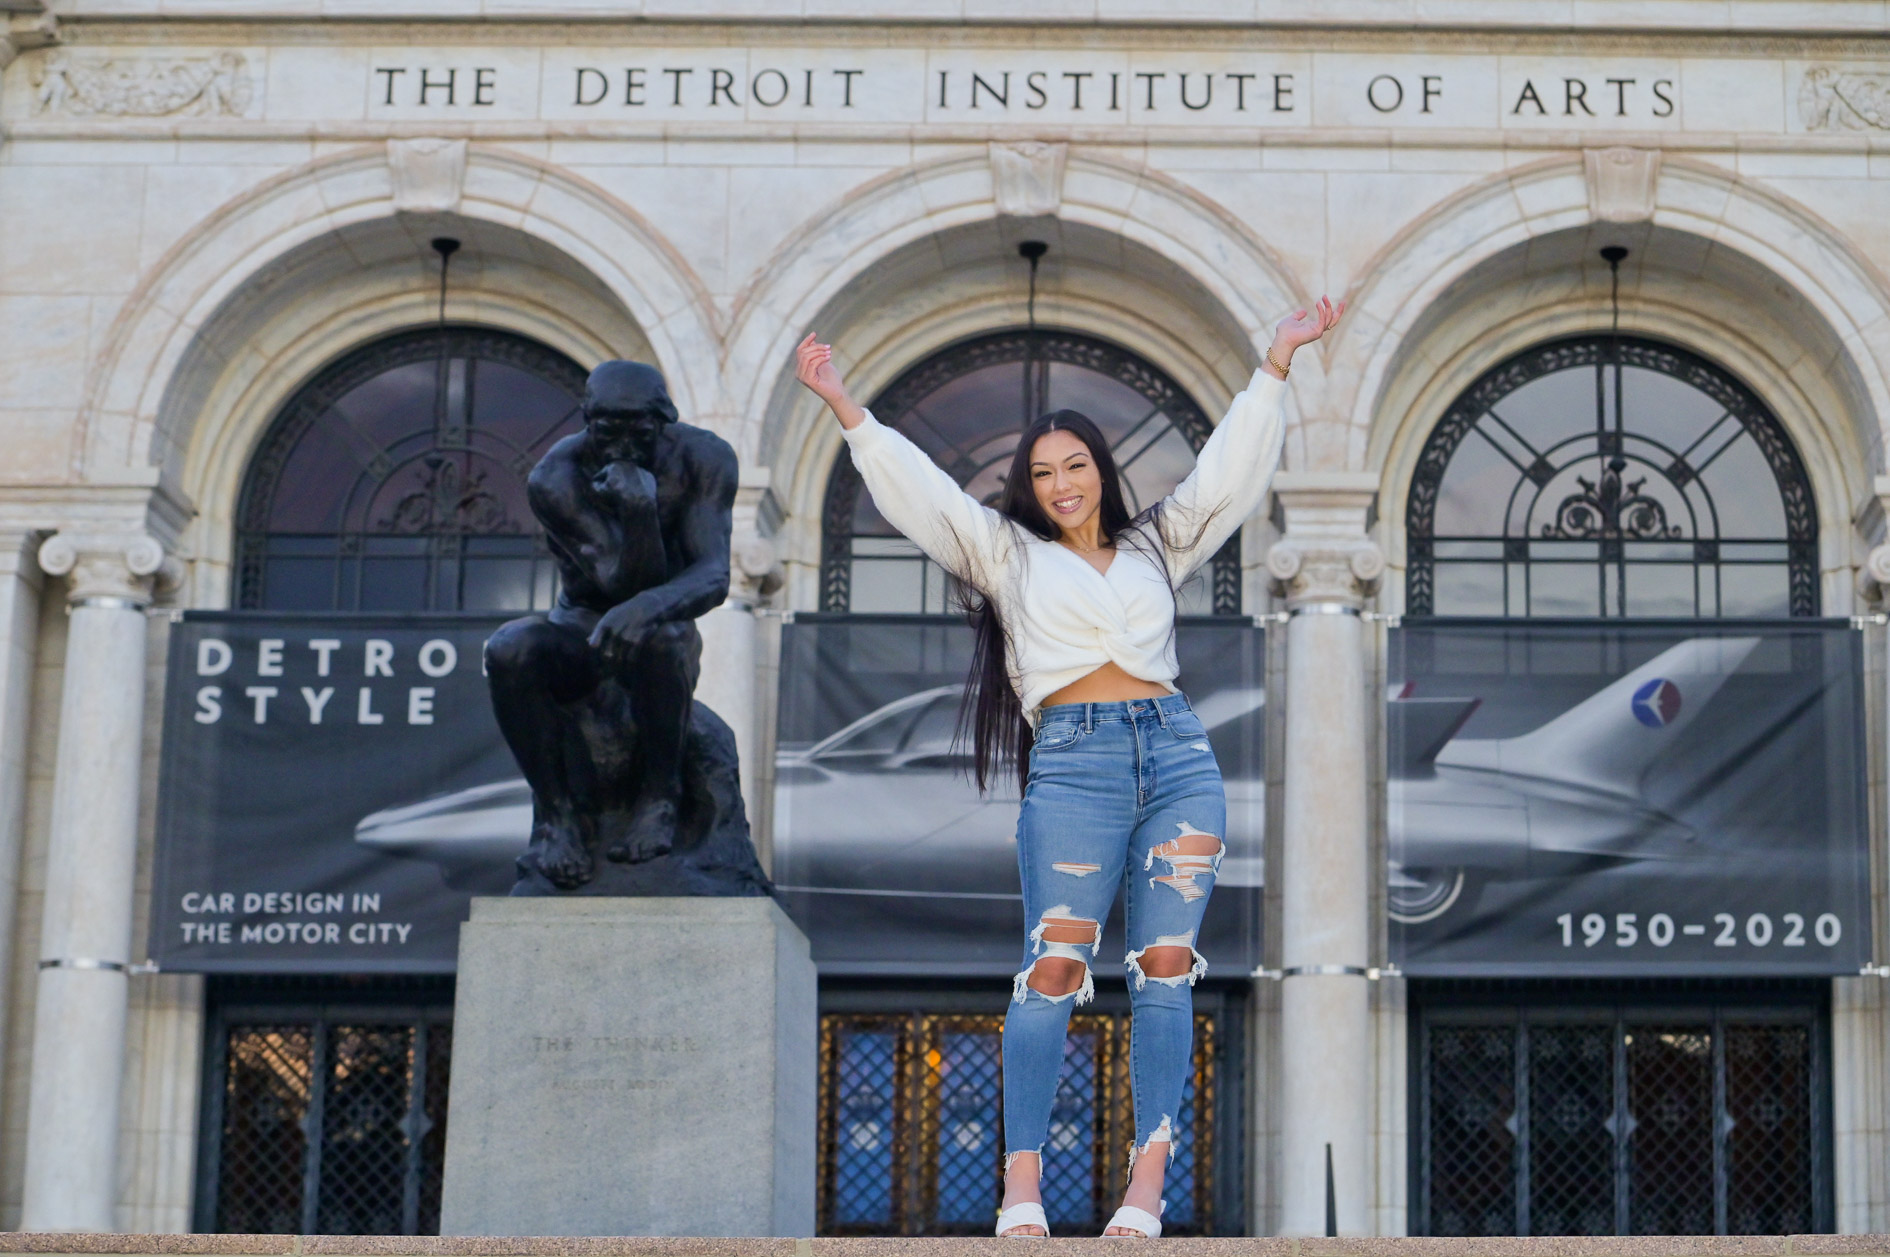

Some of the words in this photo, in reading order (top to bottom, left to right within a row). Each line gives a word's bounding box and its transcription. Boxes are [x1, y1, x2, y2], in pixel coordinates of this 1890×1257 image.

[376, 67, 496, 107] THE
[574, 67, 864, 108] DETROIT
[937, 71, 1294, 113] INSTITUTE
[1366, 75, 1443, 114] OF
[1512, 78, 1675, 117] ARTS
[197, 638, 488, 676] DETRO
[194, 685, 436, 725] STYLE
[181, 892, 235, 914] CAR
[243, 892, 344, 914] DESIGN
[352, 893, 381, 913] IN
[181, 922, 232, 944] THE
[240, 922, 341, 944] MOTOR
[349, 923, 412, 944] CITY
[533, 1036, 574, 1052] THE
[592, 1036, 699, 1052] THINKER
